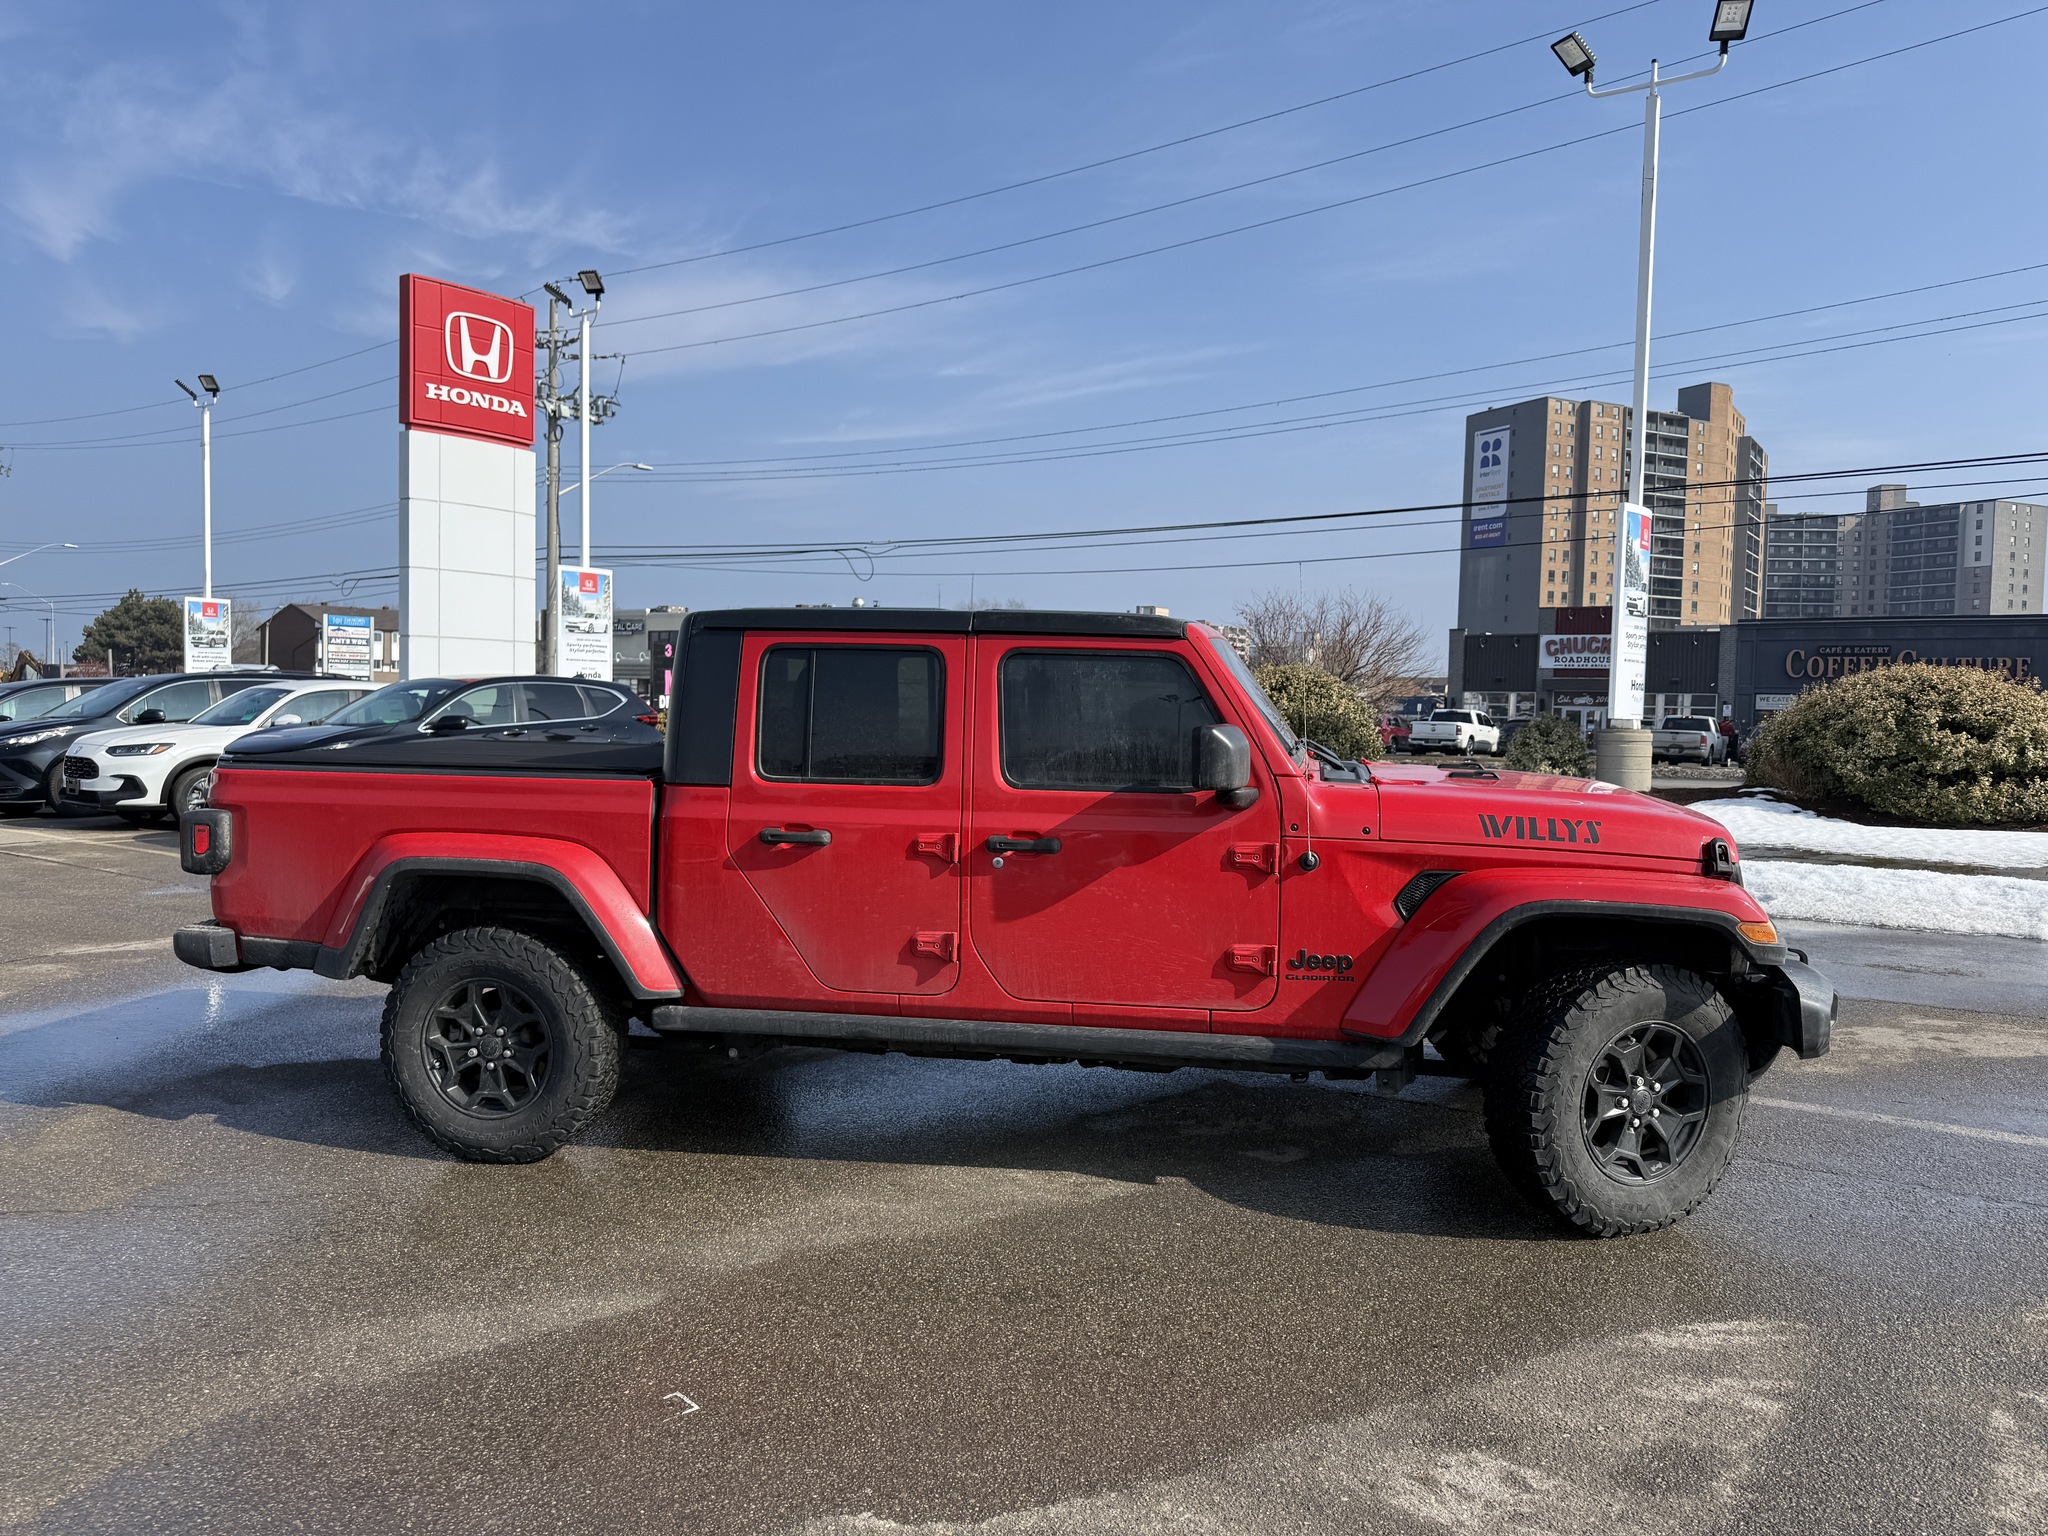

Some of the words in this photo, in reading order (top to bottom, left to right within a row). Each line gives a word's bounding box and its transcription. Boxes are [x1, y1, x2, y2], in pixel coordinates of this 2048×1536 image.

[425, 382, 528, 418] HONDA
[1474, 482, 1505, 493] APARTMENT
[1478, 489, 1501, 500] RENTALS
[1472, 521, 1504, 533] irent.com
[626, 622, 643, 631] CARE
[664, 643, 673, 657] 3
[1819, 645, 1843, 654] CAFÉ
[1854, 646, 1890, 654] EATERY
[1478, 813, 1602, 844] WILLYS
[1290, 948, 1354, 974] Jeep
[1285, 974, 1355, 982] GLADIATOR
